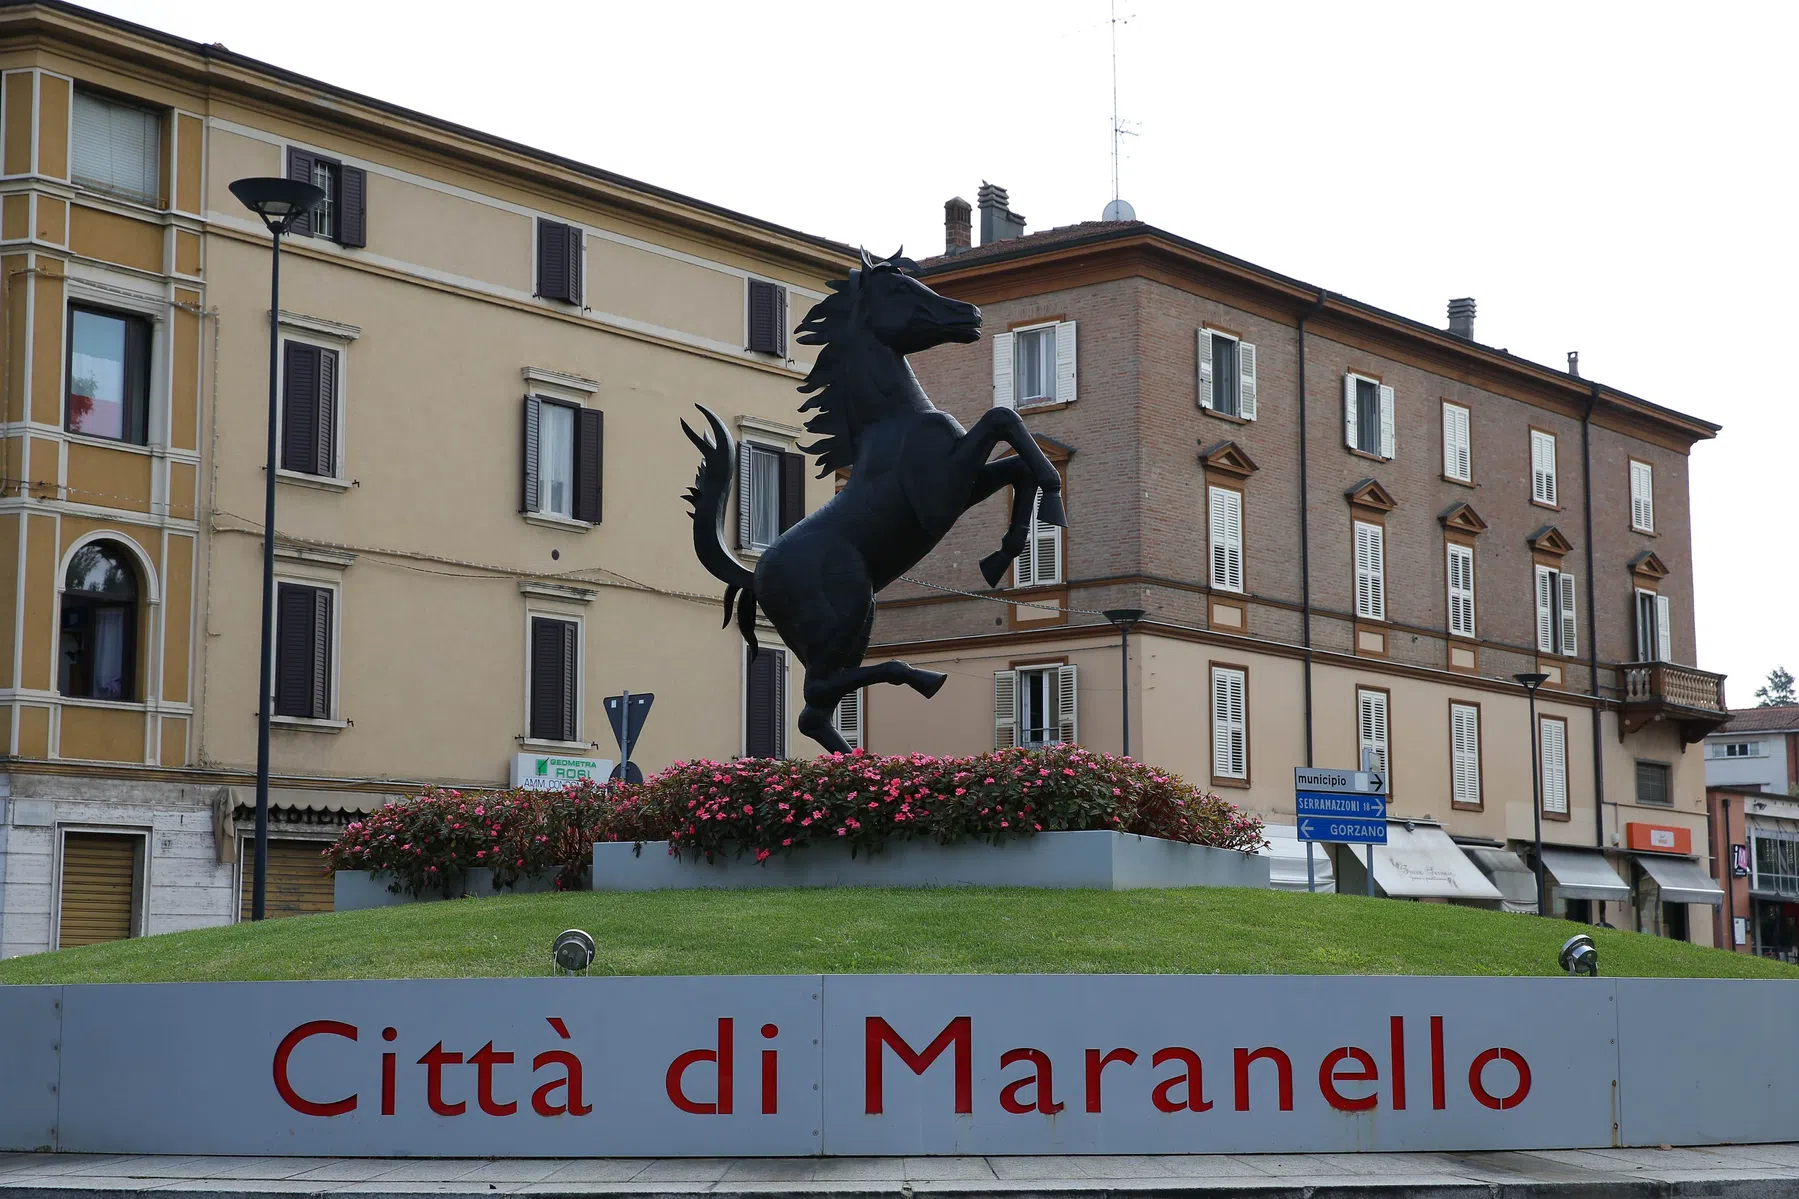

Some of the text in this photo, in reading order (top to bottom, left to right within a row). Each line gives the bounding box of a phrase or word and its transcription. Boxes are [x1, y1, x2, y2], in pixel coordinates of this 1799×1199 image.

[550, 759, 597, 768] GEOMETRA
[1298, 774, 1347, 787] municipio
[1299, 798, 1371, 812] SERRAMAZZONI 18
[1330, 824, 1385, 837] GORZANO
[273, 1015, 1532, 1117] Città di Maranello
